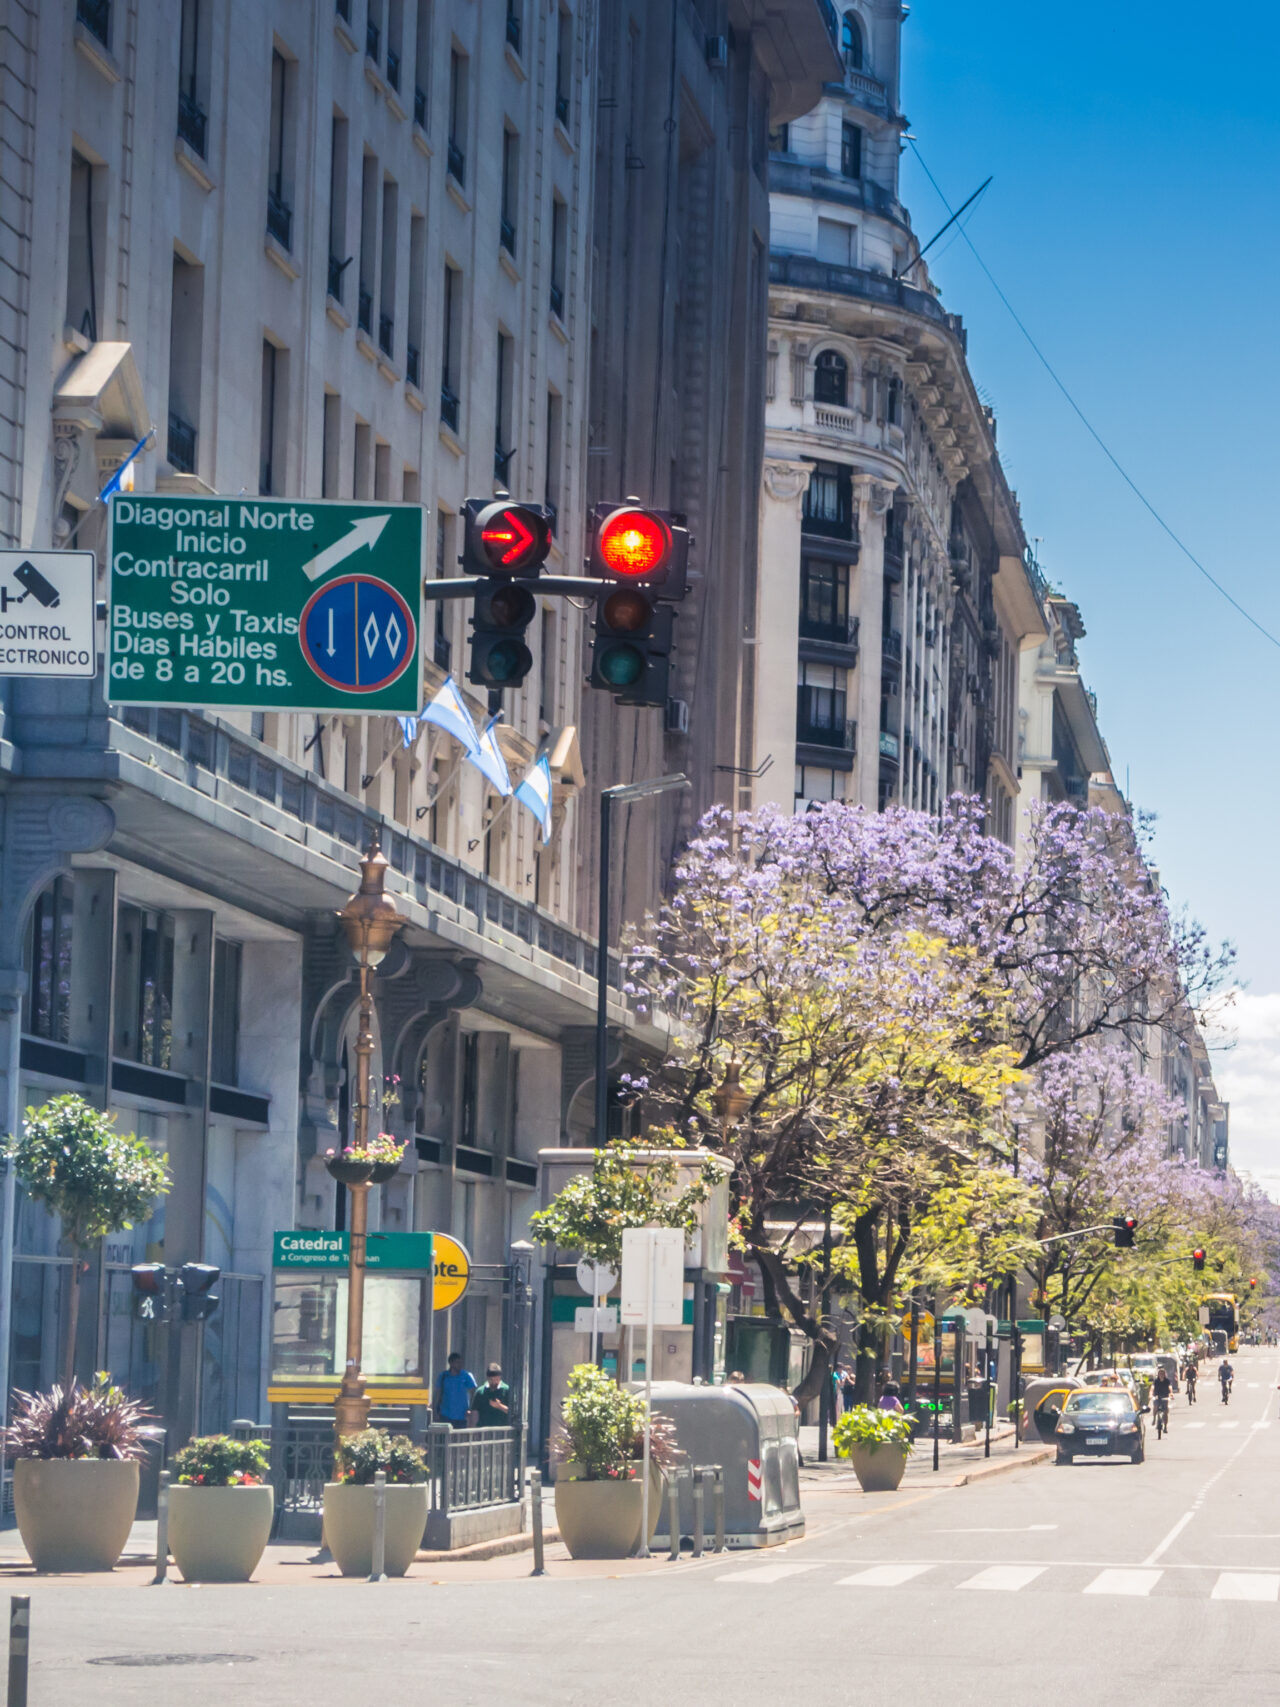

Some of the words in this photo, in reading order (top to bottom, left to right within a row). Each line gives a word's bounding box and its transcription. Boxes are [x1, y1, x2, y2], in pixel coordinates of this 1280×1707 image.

[115, 501, 230, 530] Diagonal
[239, 506, 315, 531] Norte
[176, 530, 247, 555] Inicio
[113, 551, 269, 582] Contracarril
[170, 580, 231, 606] Solo
[113, 604, 195, 630] Buses
[205, 613, 220, 636] y
[229, 609, 299, 635] Taxis
[113, 630, 170, 656] Días
[179, 633, 278, 660] Hábiles
[111, 656, 145, 680] de
[155, 658, 173, 682] 8
[184, 664, 200, 683] a
[210, 661, 246, 685] 20
[256, 663, 293, 687] hs.
[280, 1237, 342, 1250] Catedral
[288, 1253, 326, 1263] Congreso
[329, 1252, 340, 1262] de
